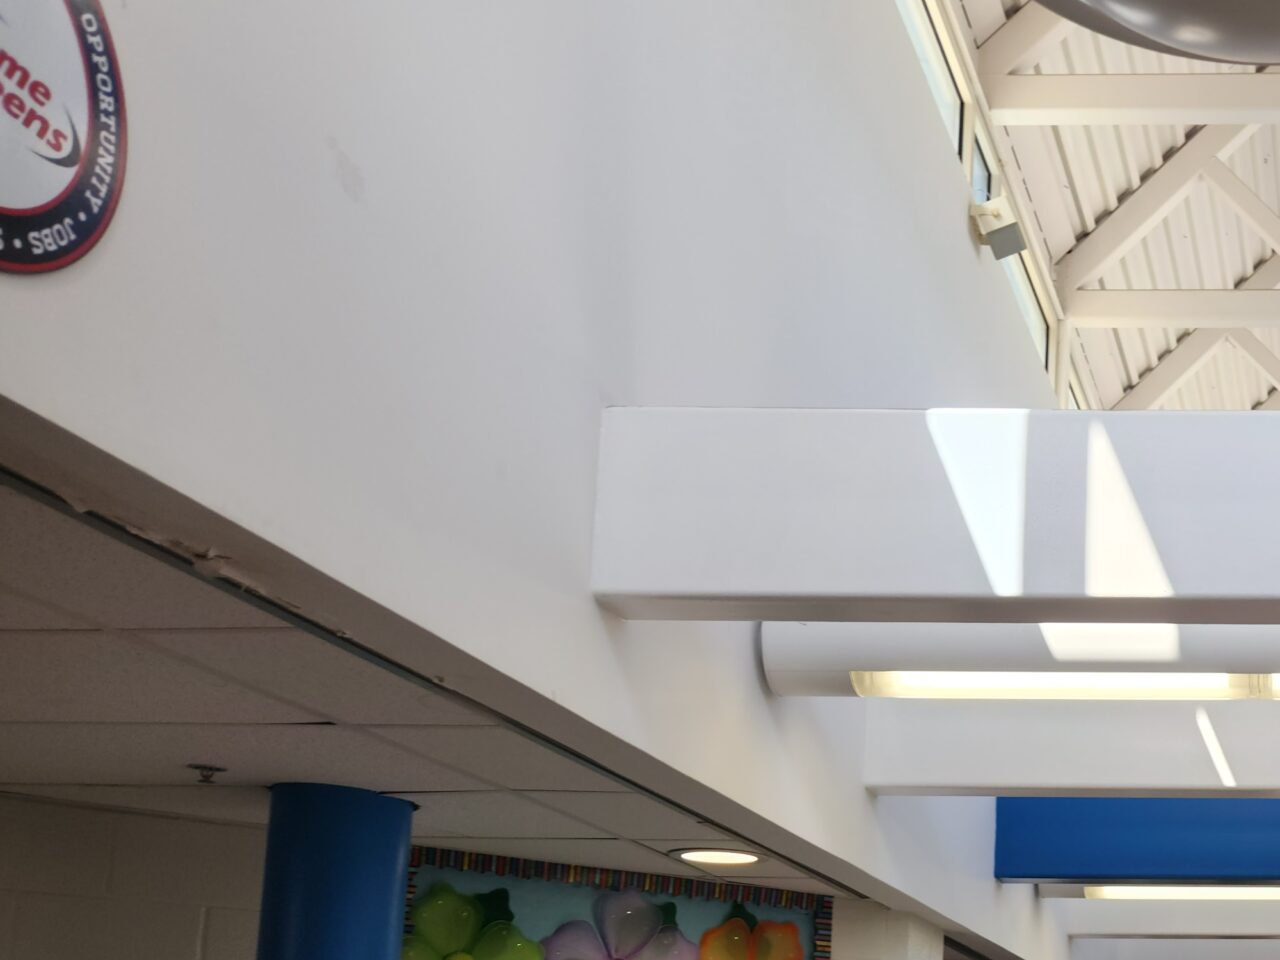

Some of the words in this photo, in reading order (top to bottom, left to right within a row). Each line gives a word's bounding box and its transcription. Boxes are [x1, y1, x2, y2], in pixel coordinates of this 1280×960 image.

[0, 82, 68, 152] ens
[80, 13, 117, 214] OPPORTUNITY
[27, 217, 77, 255] JOBS
